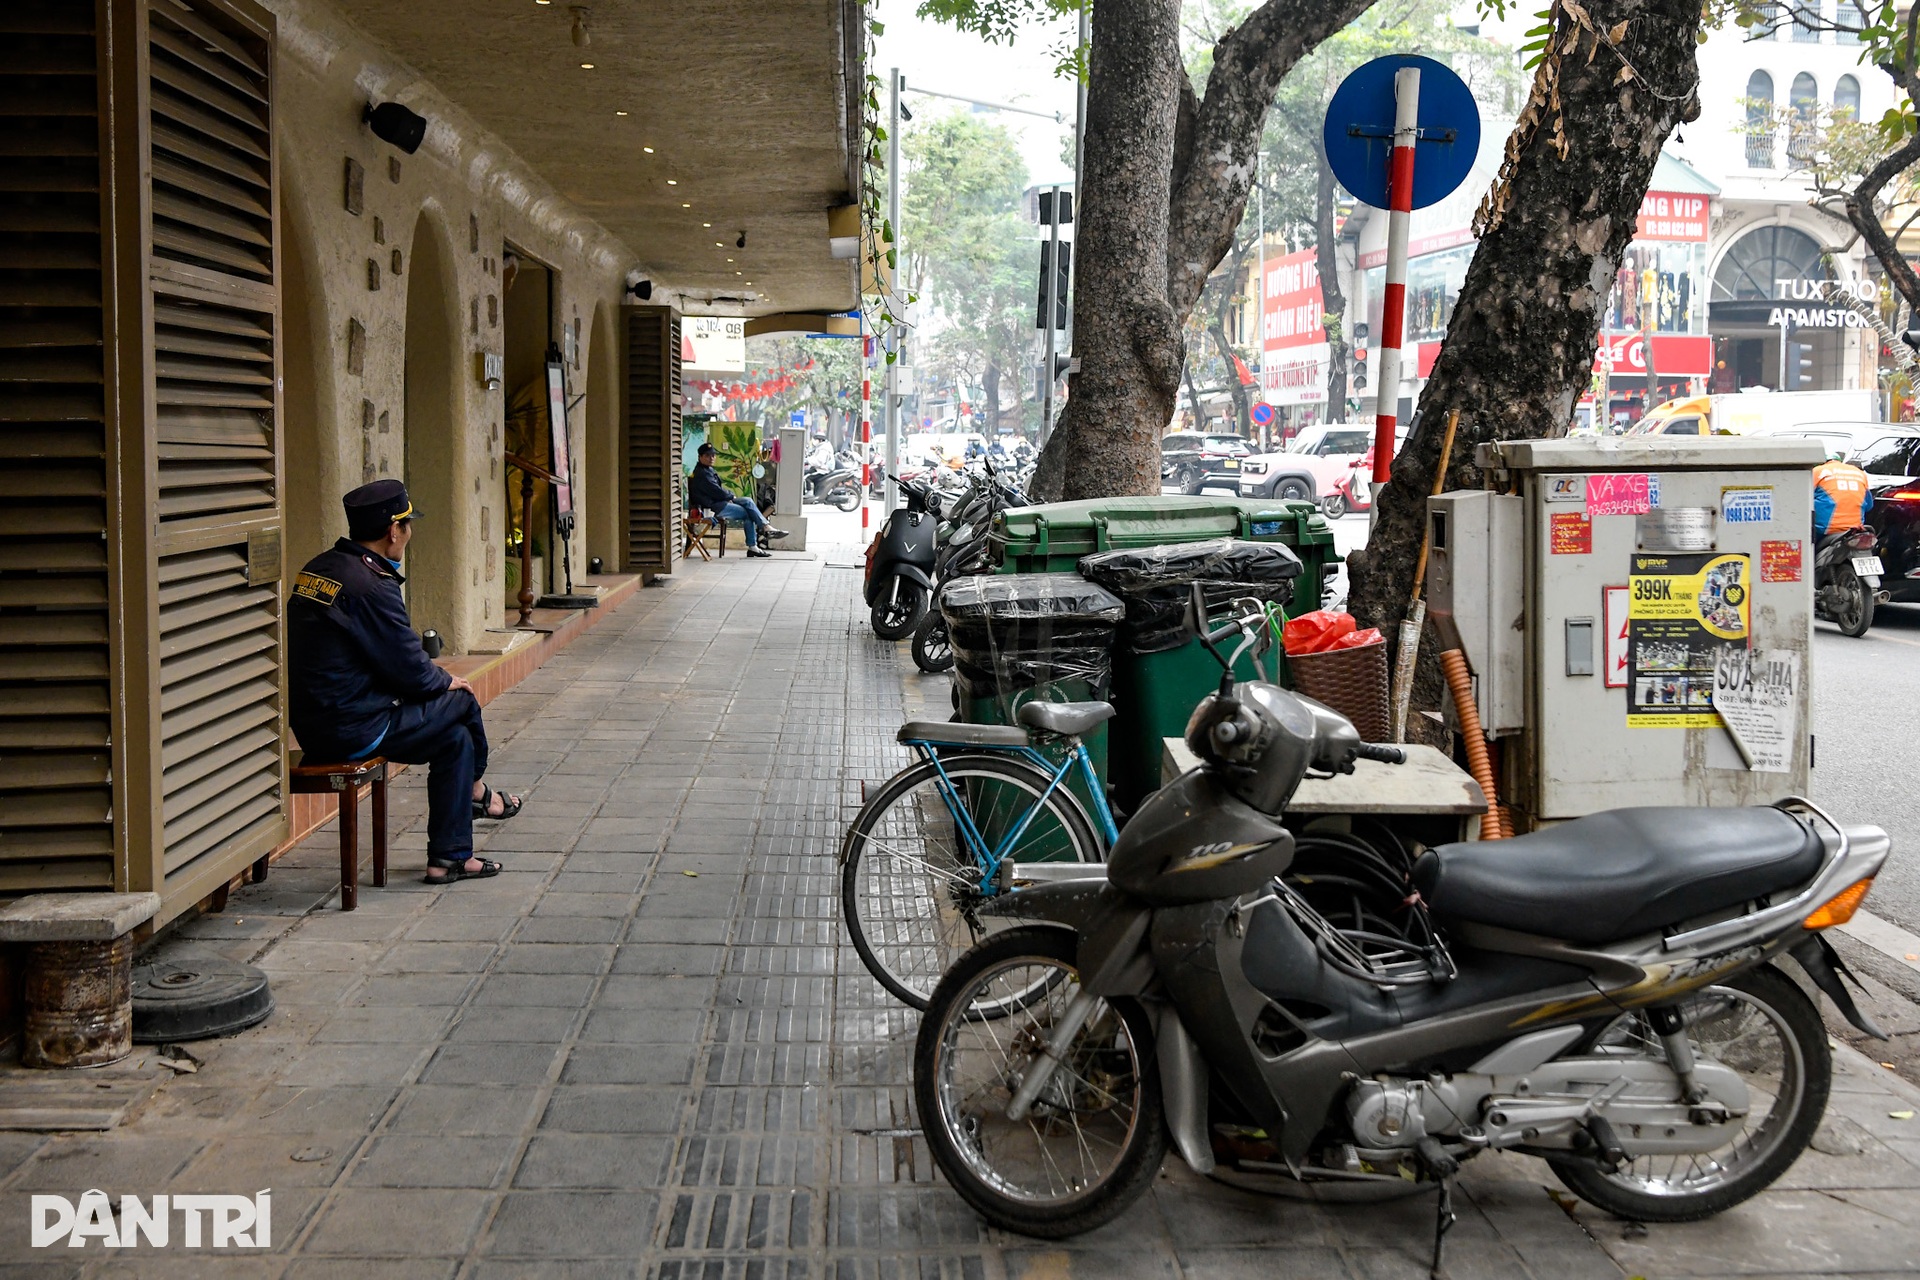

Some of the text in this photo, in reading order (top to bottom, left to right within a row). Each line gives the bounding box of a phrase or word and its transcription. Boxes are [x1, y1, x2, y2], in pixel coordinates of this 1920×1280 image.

[1673, 198, 1703, 218] VIP
[1775, 279, 1876, 300] TUXDO
[1264, 305, 1296, 341] CHÍNH
[1634, 579, 1672, 600] 399K
[1187, 842, 1233, 858] 110
